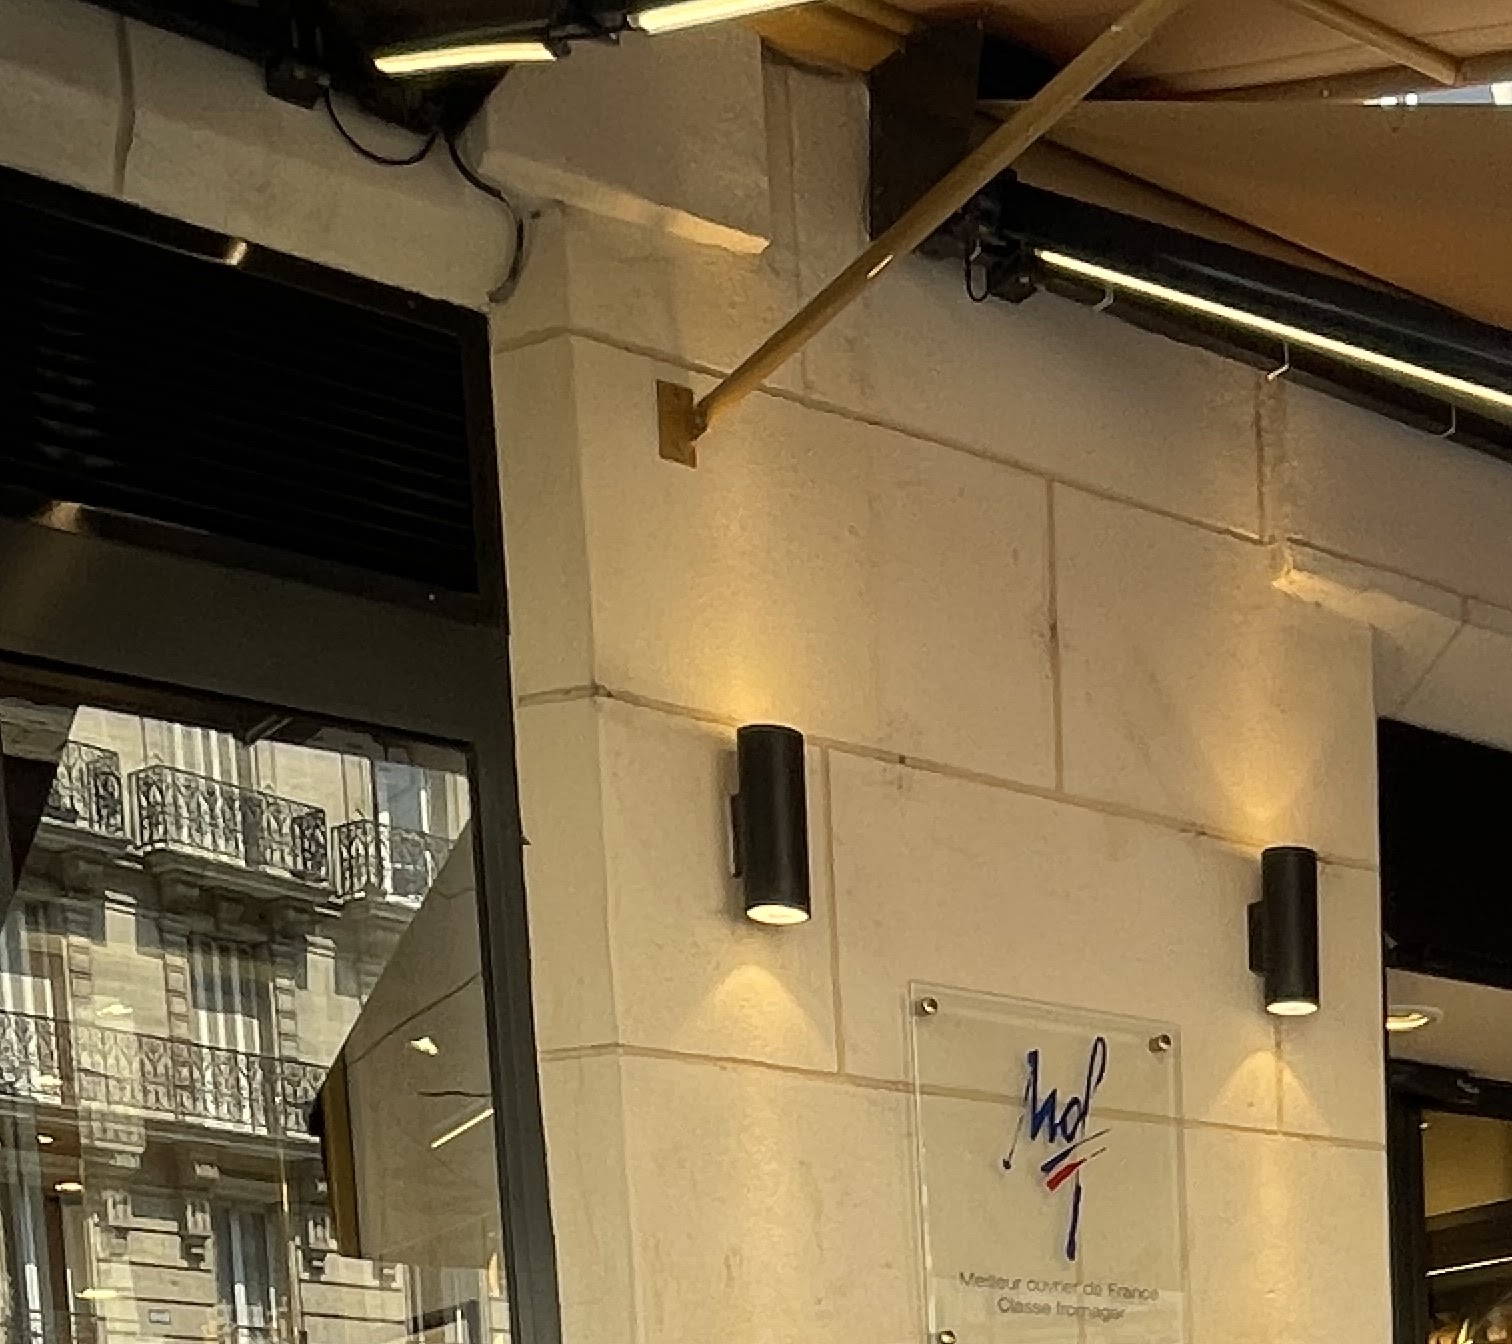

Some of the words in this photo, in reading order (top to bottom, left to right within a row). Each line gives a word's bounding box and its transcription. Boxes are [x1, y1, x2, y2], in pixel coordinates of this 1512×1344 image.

[1083, 1281, 1102, 1298] de
[1107, 1282, 1160, 1302] France
[996, 1296, 1052, 1316] Classe
